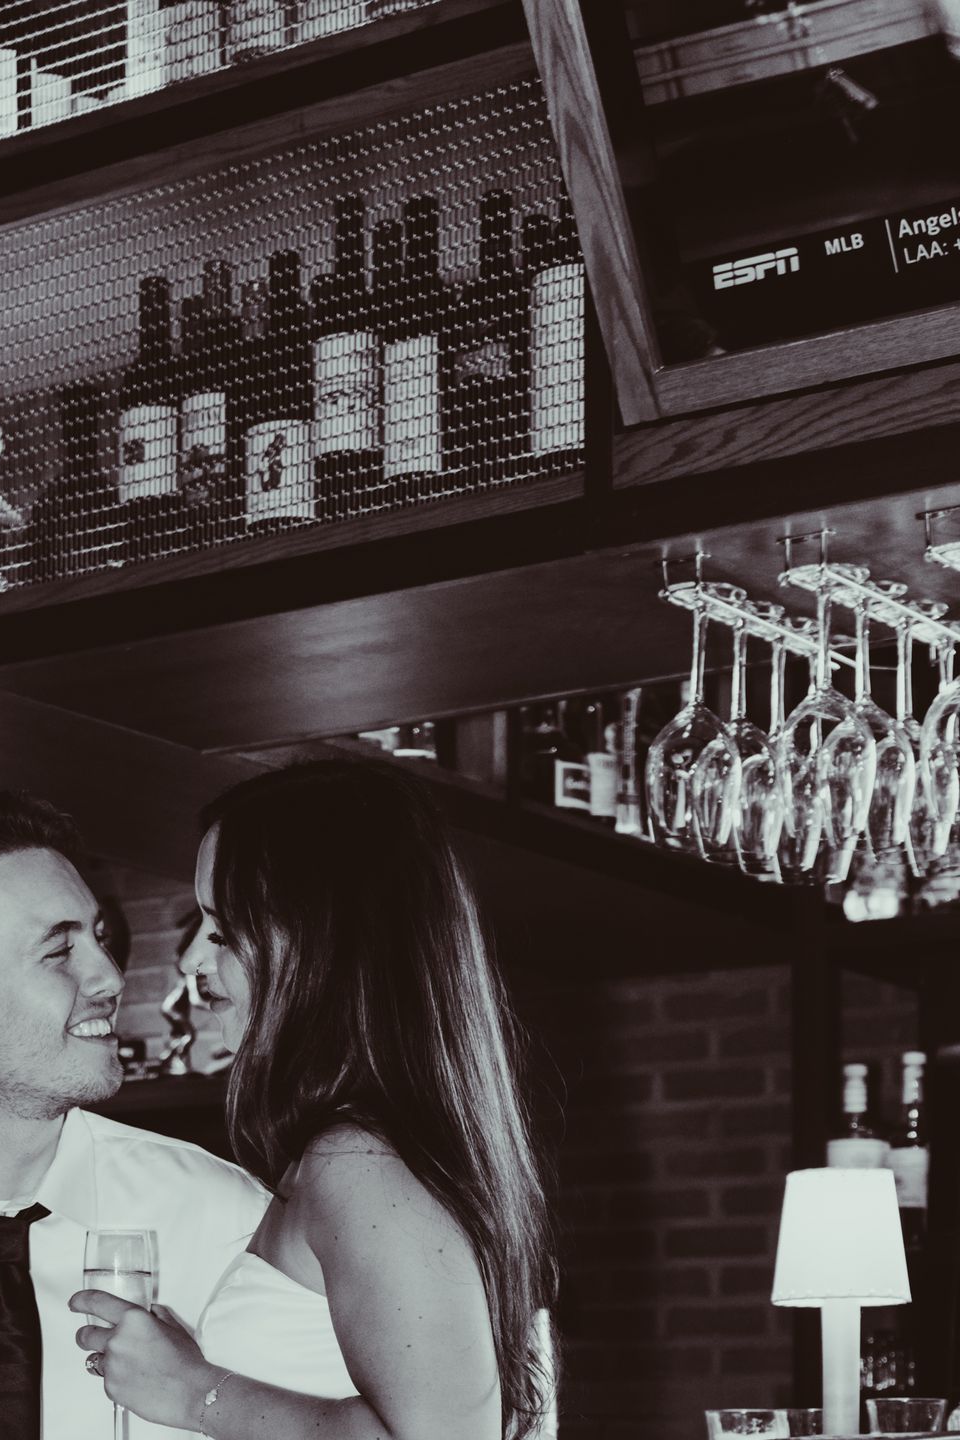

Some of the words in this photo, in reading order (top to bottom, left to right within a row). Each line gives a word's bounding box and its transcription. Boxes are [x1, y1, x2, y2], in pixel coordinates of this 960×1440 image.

[899, 206, 960, 239] Angel
[824, 233, 865, 256] MLB
[903, 240, 949, 264] LAA:
[712, 247, 800, 290] ESPN
